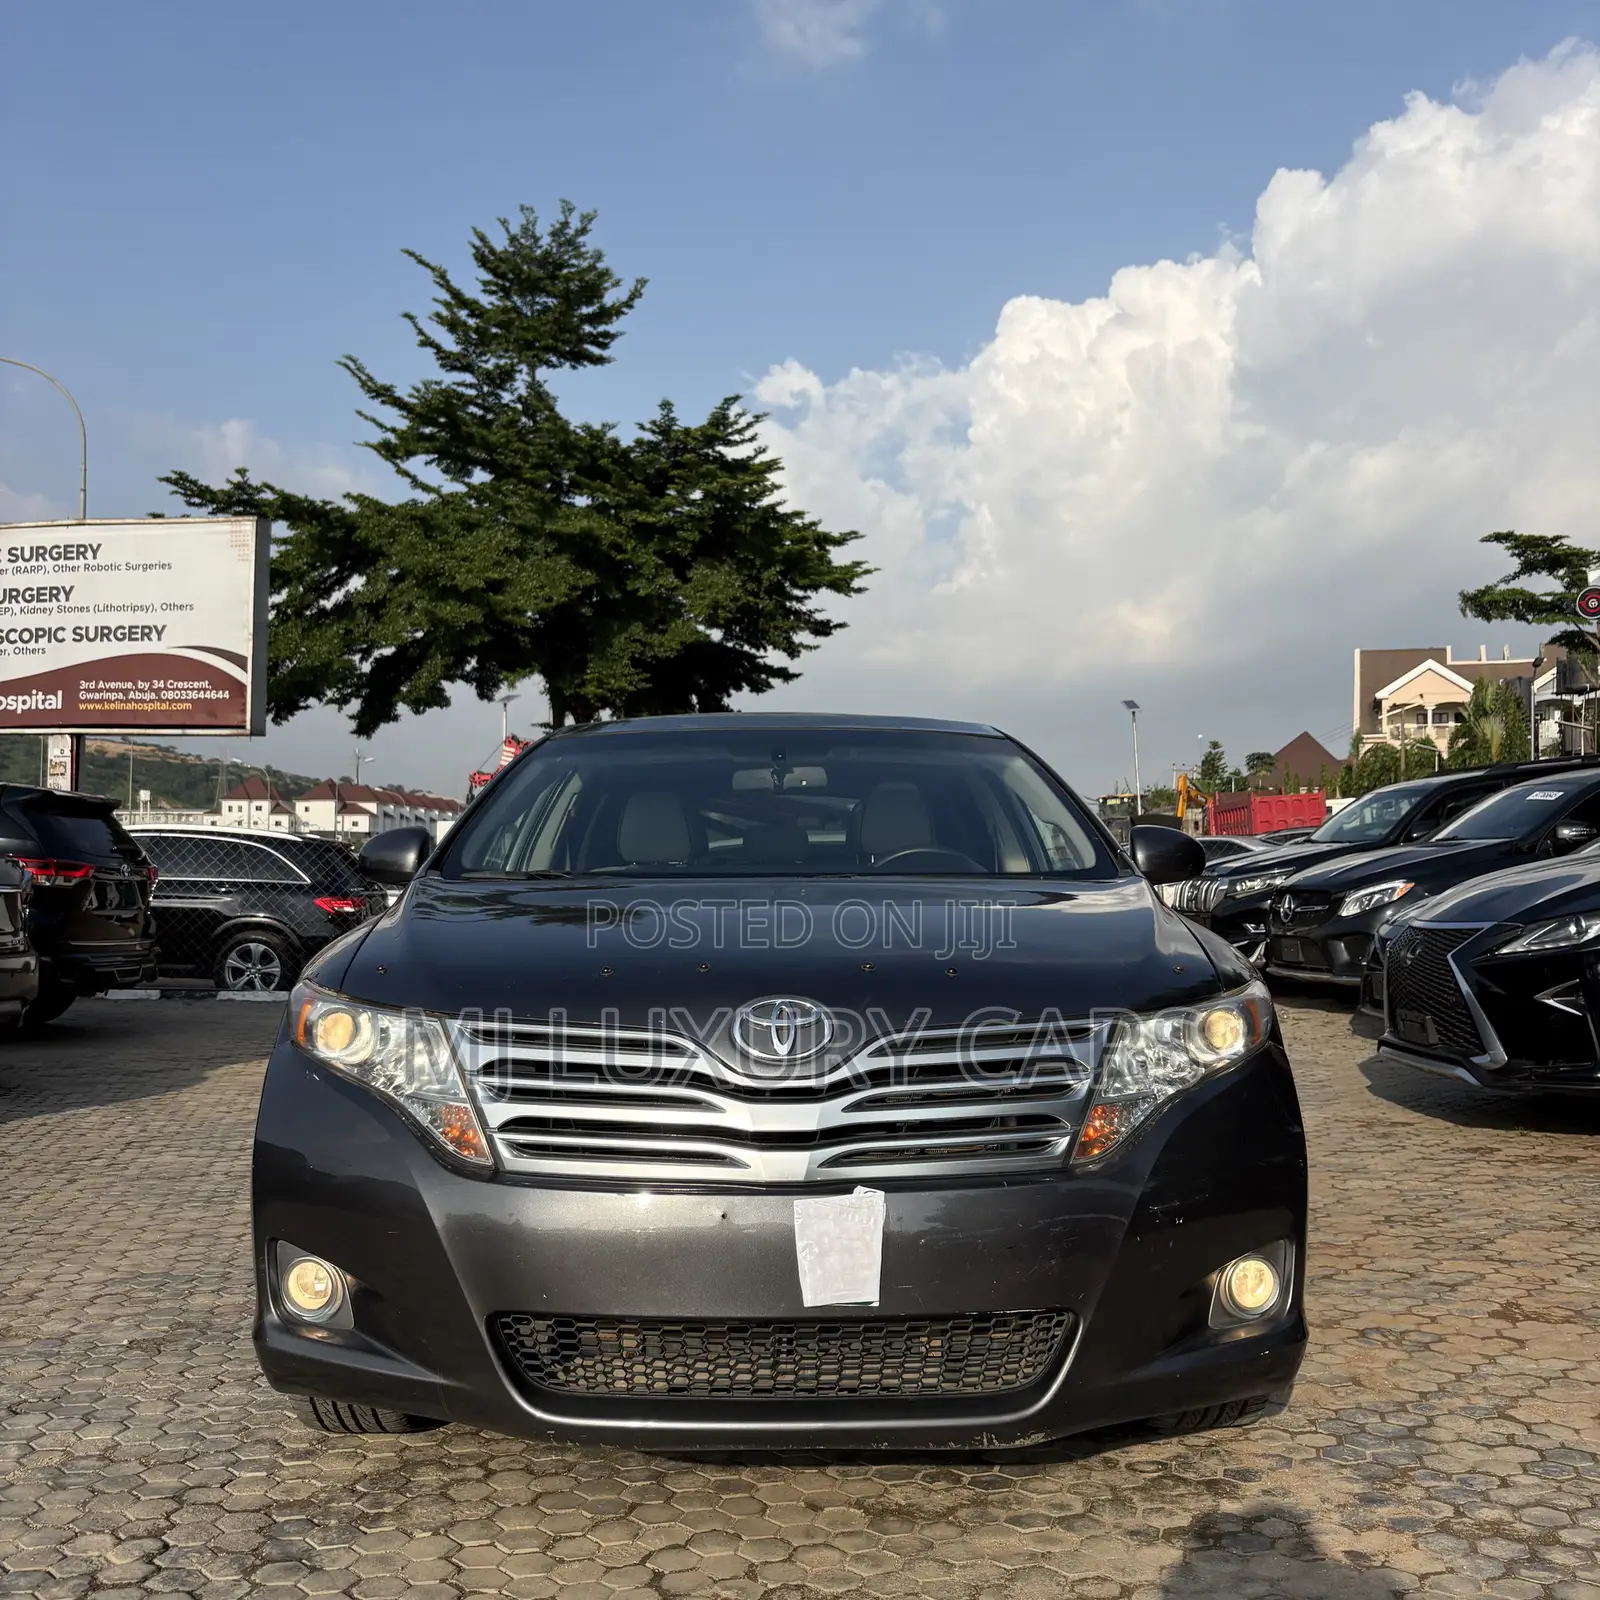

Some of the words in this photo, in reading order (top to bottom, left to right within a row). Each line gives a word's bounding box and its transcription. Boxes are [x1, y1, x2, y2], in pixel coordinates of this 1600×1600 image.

[7, 543, 102, 563] SURGERY
[11, 564, 50, 576] (RARP),
[52, 563, 81, 573] Other
[83, 562, 122, 572] Robotic
[124, 560, 172, 573] Surgeries
[20, 605, 54, 616] Kidney
[56, 604, 91, 614] Stones
[93, 602, 157, 614] (Lithotripsy),
[160, 602, 194, 612] Others
[72, 624, 167, 643] SURGERY
[13, 646, 46, 656] Others
[79, 680, 95, 690] 3rd
[97, 680, 136, 690] Avenue,
[137, 680, 150, 691] by
[152, 680, 164, 690] 34
[167, 680, 212, 690] Crescent,
[79, 690, 126, 702] Gwarinpa,
[160, 690, 230, 700] 08033644644
[79, 700, 192, 712] www.kelinahospital.com
